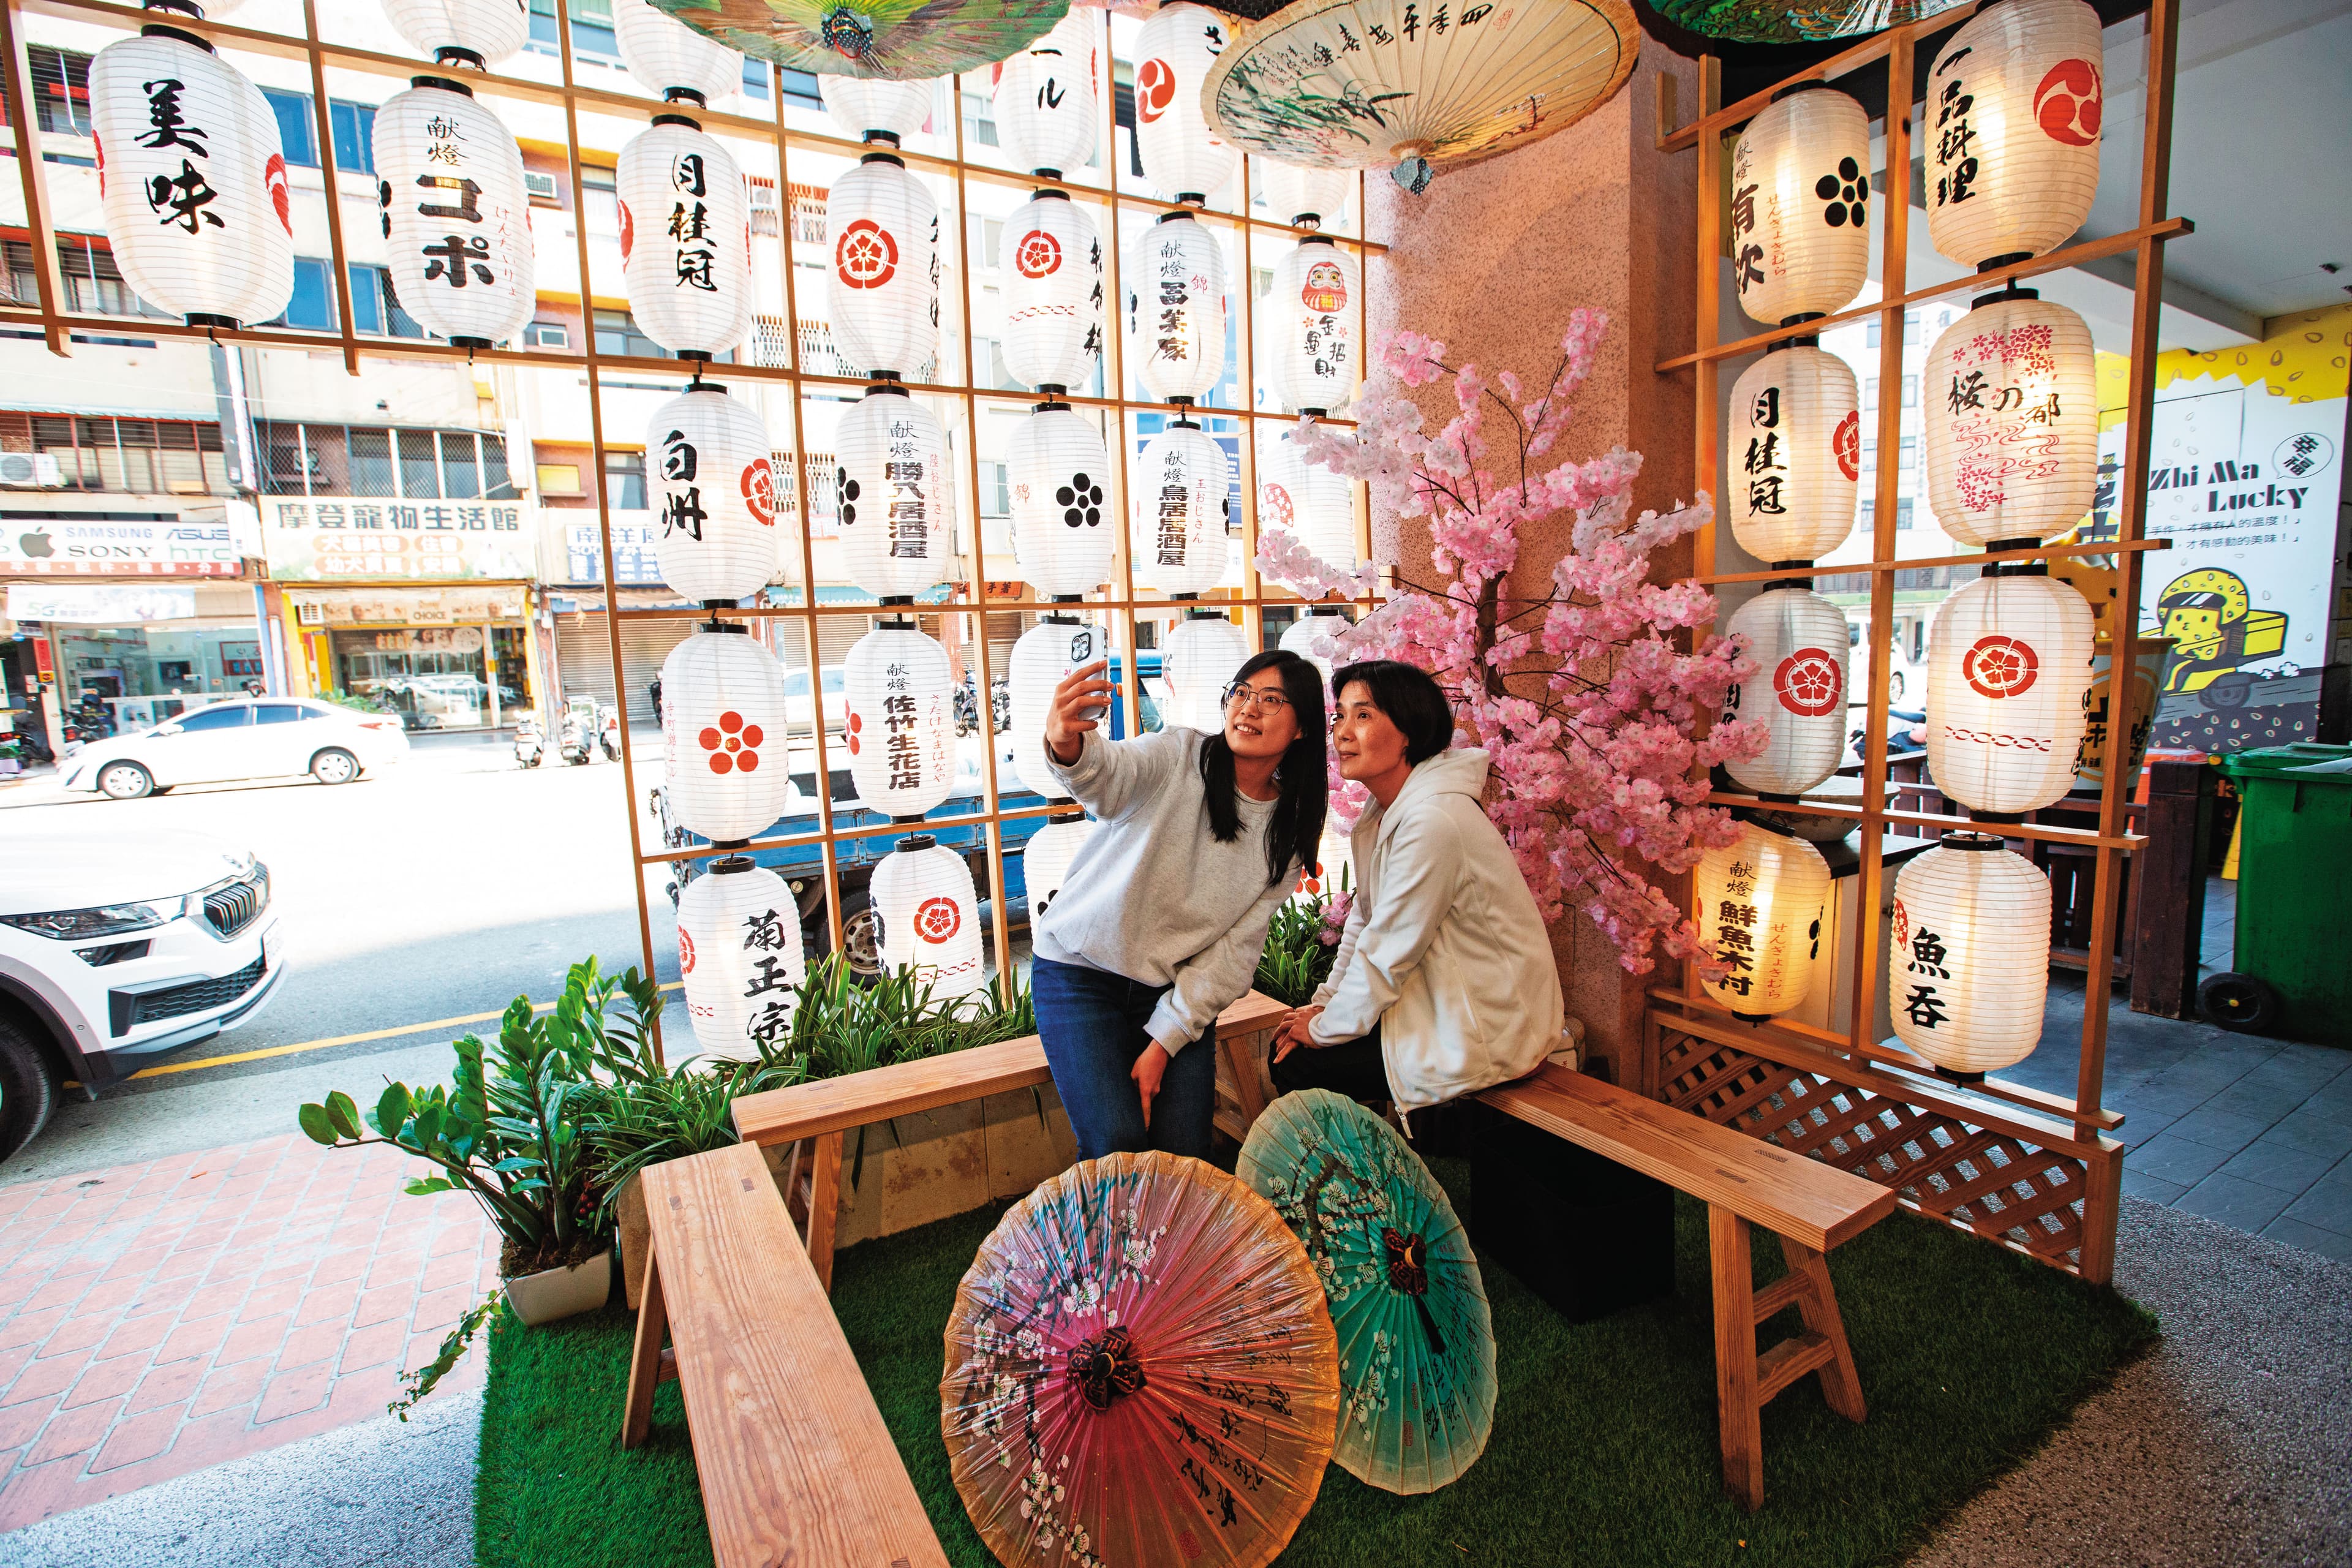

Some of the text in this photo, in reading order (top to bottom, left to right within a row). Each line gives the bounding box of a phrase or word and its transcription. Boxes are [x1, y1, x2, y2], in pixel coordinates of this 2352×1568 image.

[134, 78, 225, 235] 美味
[1936, 46, 1978, 207] 一品料理
[668, 154, 718, 292] 月桂冠
[660, 429, 708, 541] 白州
[1744, 386, 1788, 518] 月桂冠
[2148, 459, 2260, 491] Zhi Ma
[2207, 483, 2310, 513] Lucky
[65, 527, 153, 539] SAMSUNG
[68, 545, 154, 557] SONY
[741, 908, 793, 1041] 菊正宗
